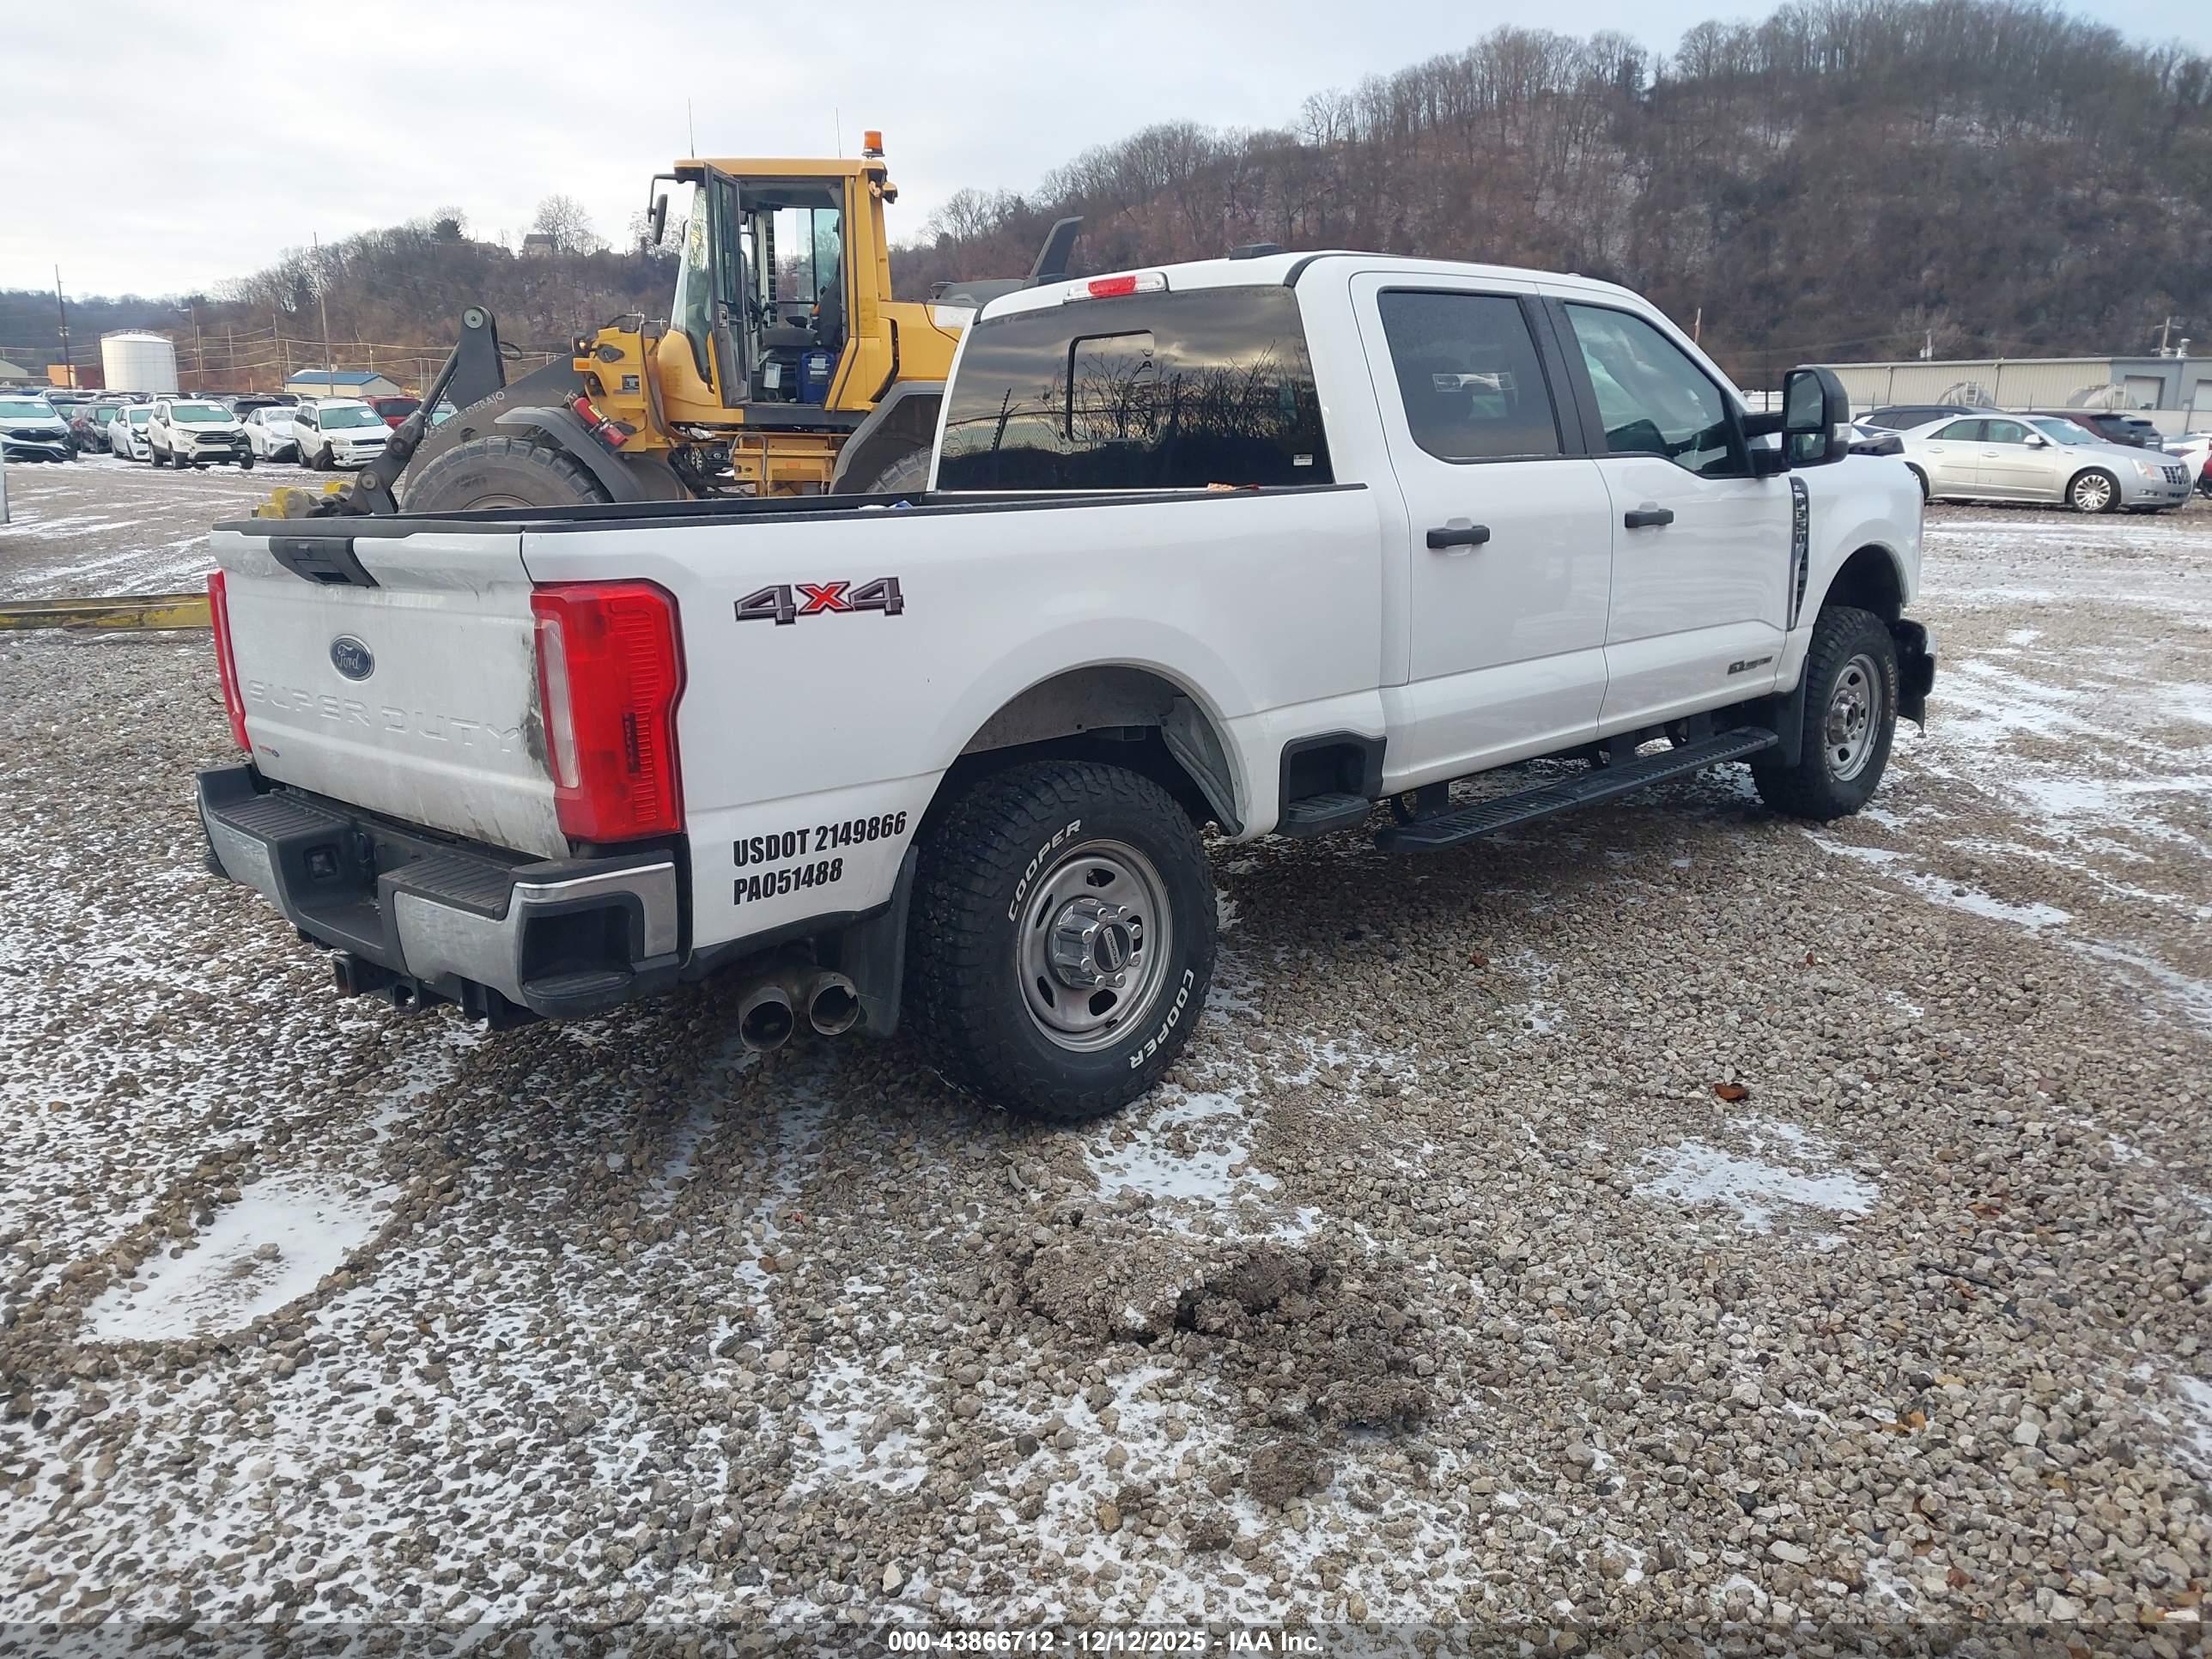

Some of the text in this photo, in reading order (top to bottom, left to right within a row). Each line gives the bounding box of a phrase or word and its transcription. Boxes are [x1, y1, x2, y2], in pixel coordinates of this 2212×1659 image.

[247, 679, 520, 753] SUPER DUTY
[733, 811, 908, 867] USDOT 2149866
[1007, 818, 1082, 923] COOPER
[733, 858, 843, 905] PA051488
[1128, 968, 1195, 1071] COOPER
